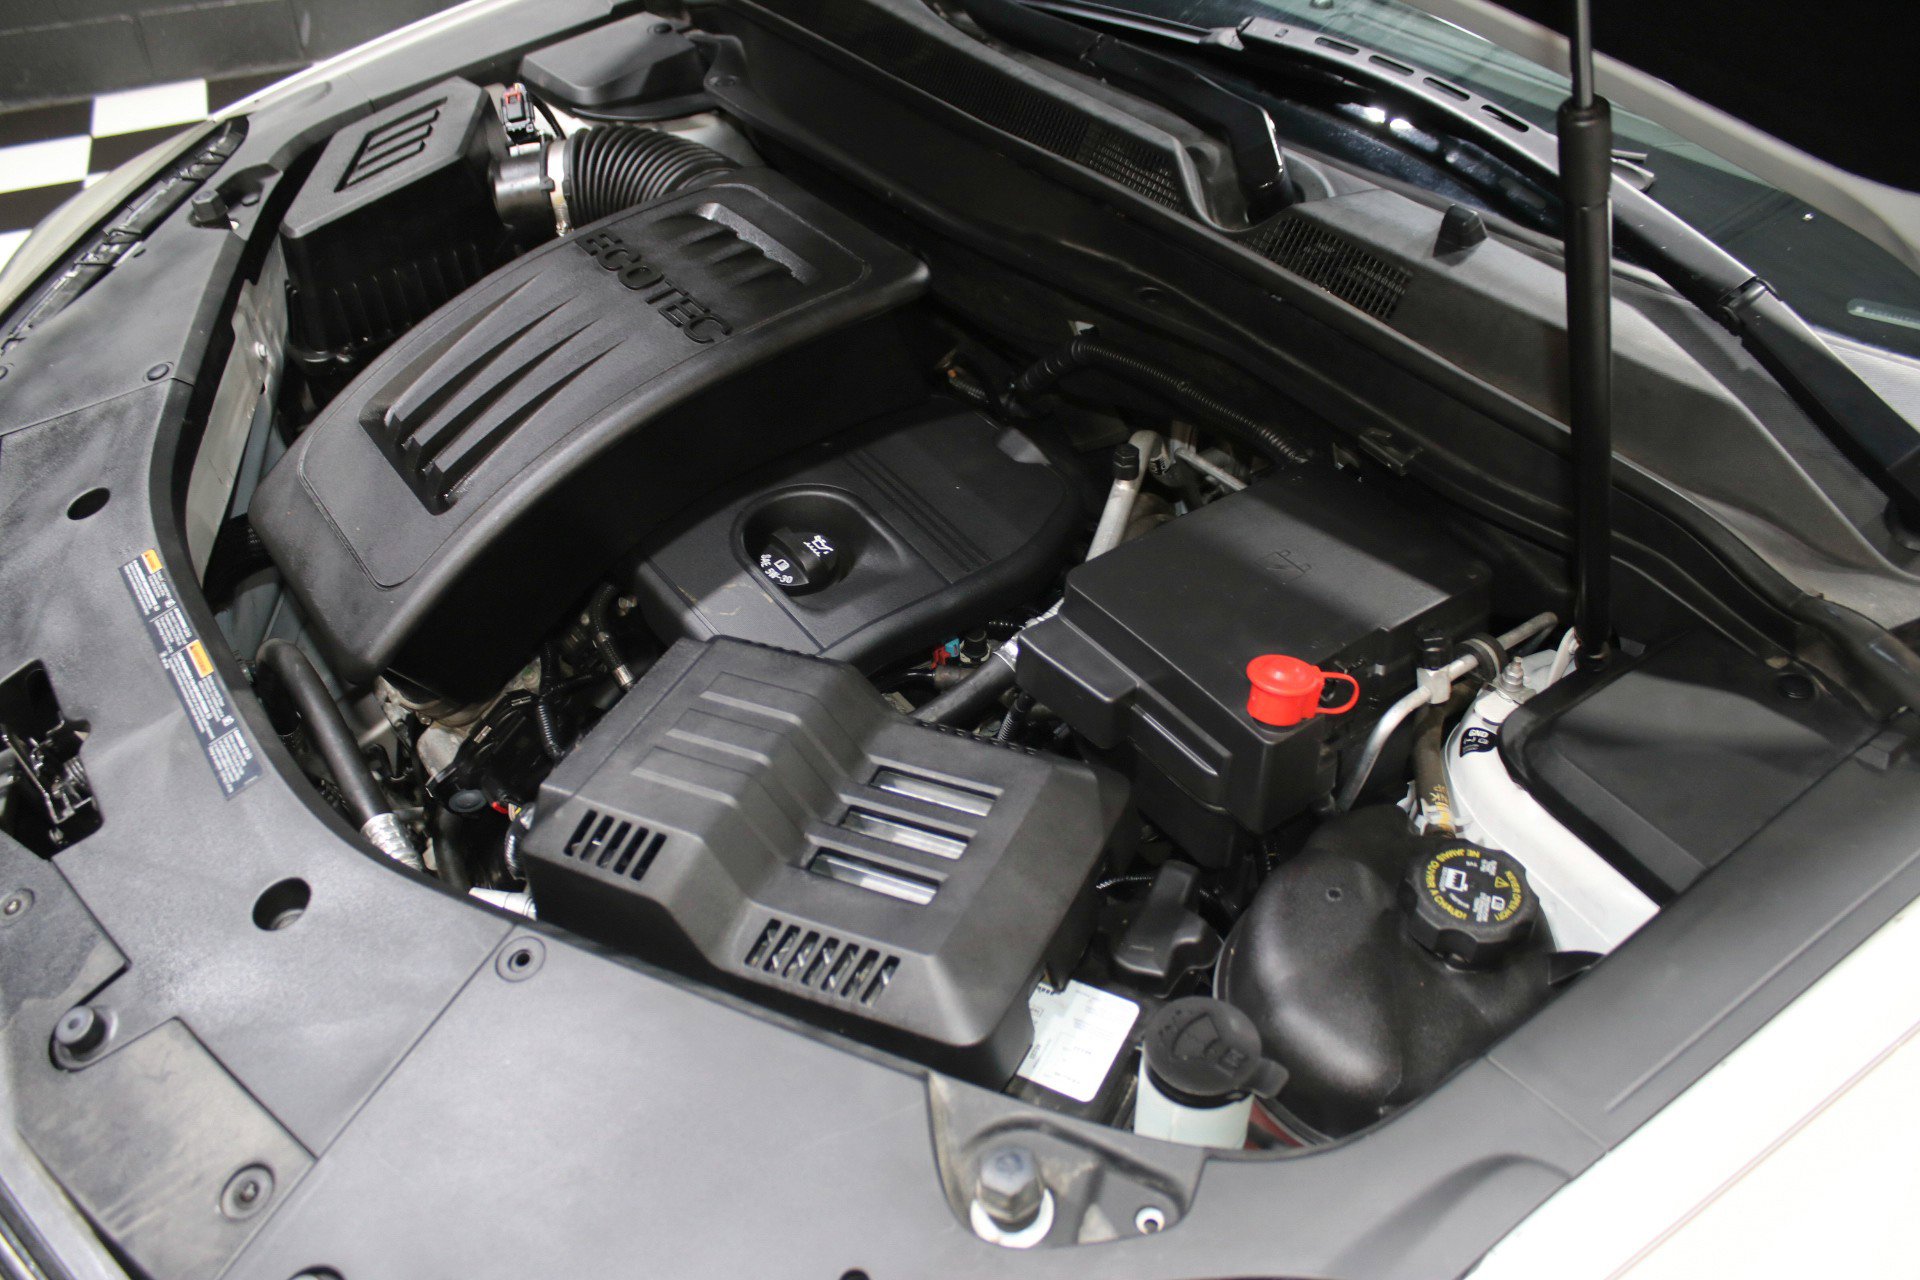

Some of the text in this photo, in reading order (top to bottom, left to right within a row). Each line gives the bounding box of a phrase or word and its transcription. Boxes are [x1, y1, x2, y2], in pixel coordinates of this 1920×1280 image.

[575, 229, 733, 344] ECOTEC
[760, 554, 794, 584] SAE 5W-30
[1436, 848, 1465, 862] JAMAIS
